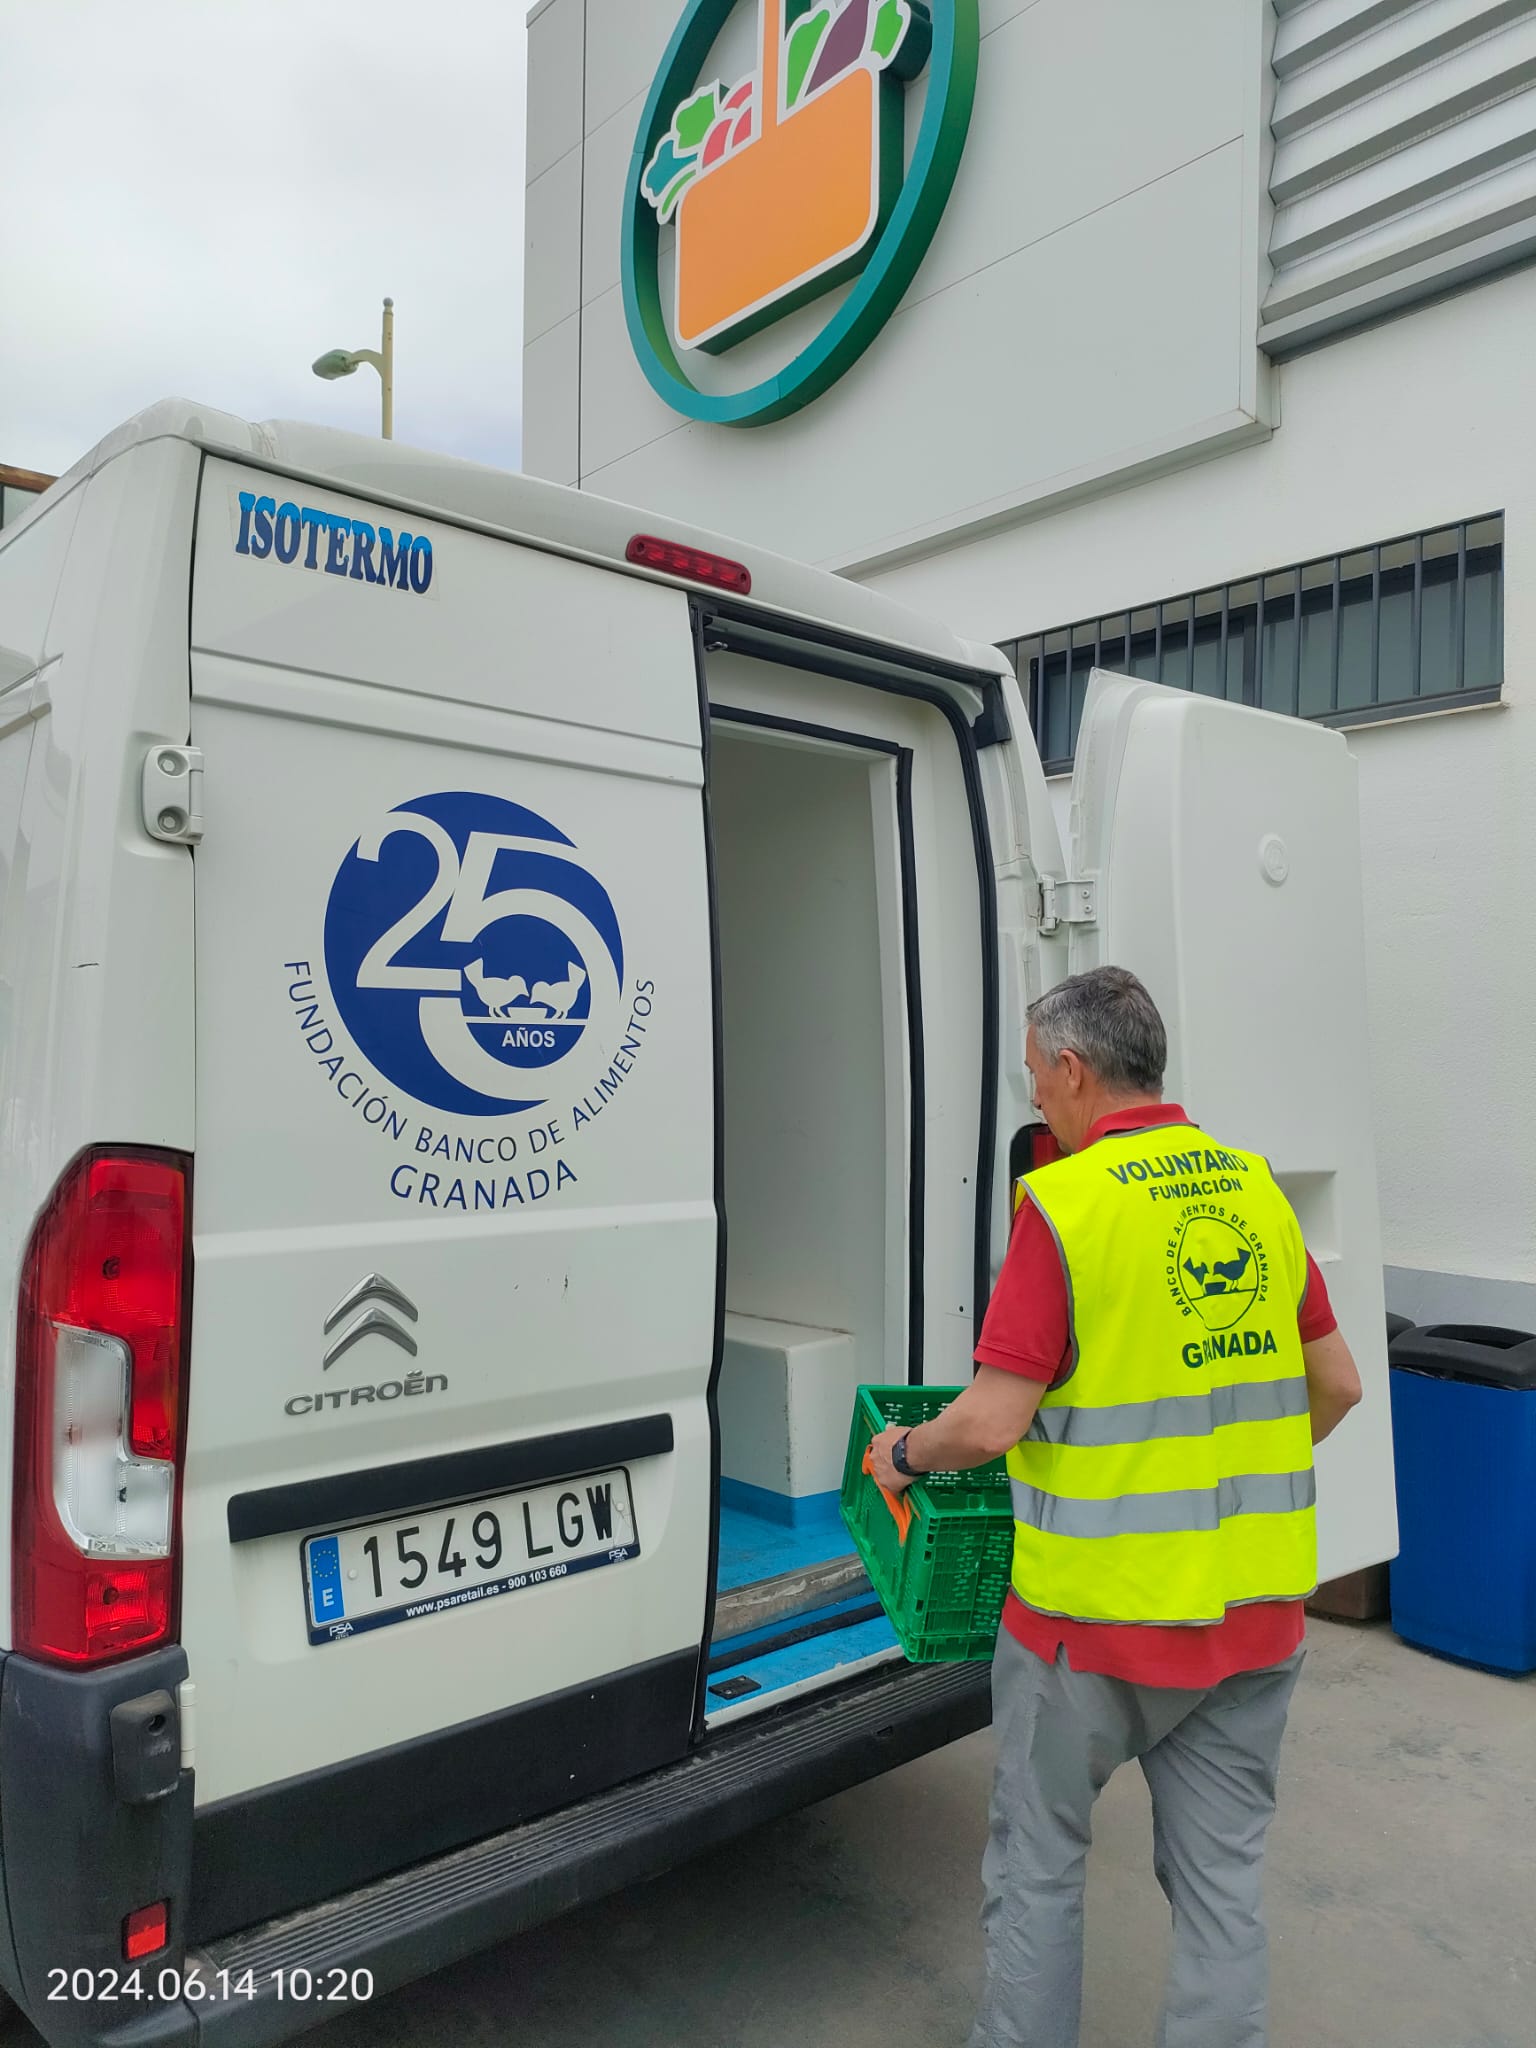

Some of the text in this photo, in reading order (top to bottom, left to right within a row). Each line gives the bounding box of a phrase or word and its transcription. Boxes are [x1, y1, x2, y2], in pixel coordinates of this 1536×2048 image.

[235, 491, 433, 594] ISOTERMO
[355, 811, 621, 1101] 25
[284, 961, 655, 1164] FUNDACIÓN BANCO DE ALIMENTOS
[502, 1027, 556, 1048] AÑOS
[390, 1159, 578, 1210] GRANADA
[1106, 1149, 1249, 1185] VOLUNTARIO
[1148, 1175, 1243, 1201] FUNDACIÓN
[1166, 1204, 1269, 1316] BANCO DE ALMENTOS DE GRANADA
[363, 1483, 613, 1598] 1549 LGW
[608, 1547, 629, 1560] PSA
[322, 1587, 334, 1607] E
[406, 1582, 500, 1618] www.psaretail.es
[508, 1575, 527, 1590] 900
[529, 1569, 547, 1584] 103
[549, 1564, 568, 1578] 660
[329, 1622, 354, 1637] PSA
